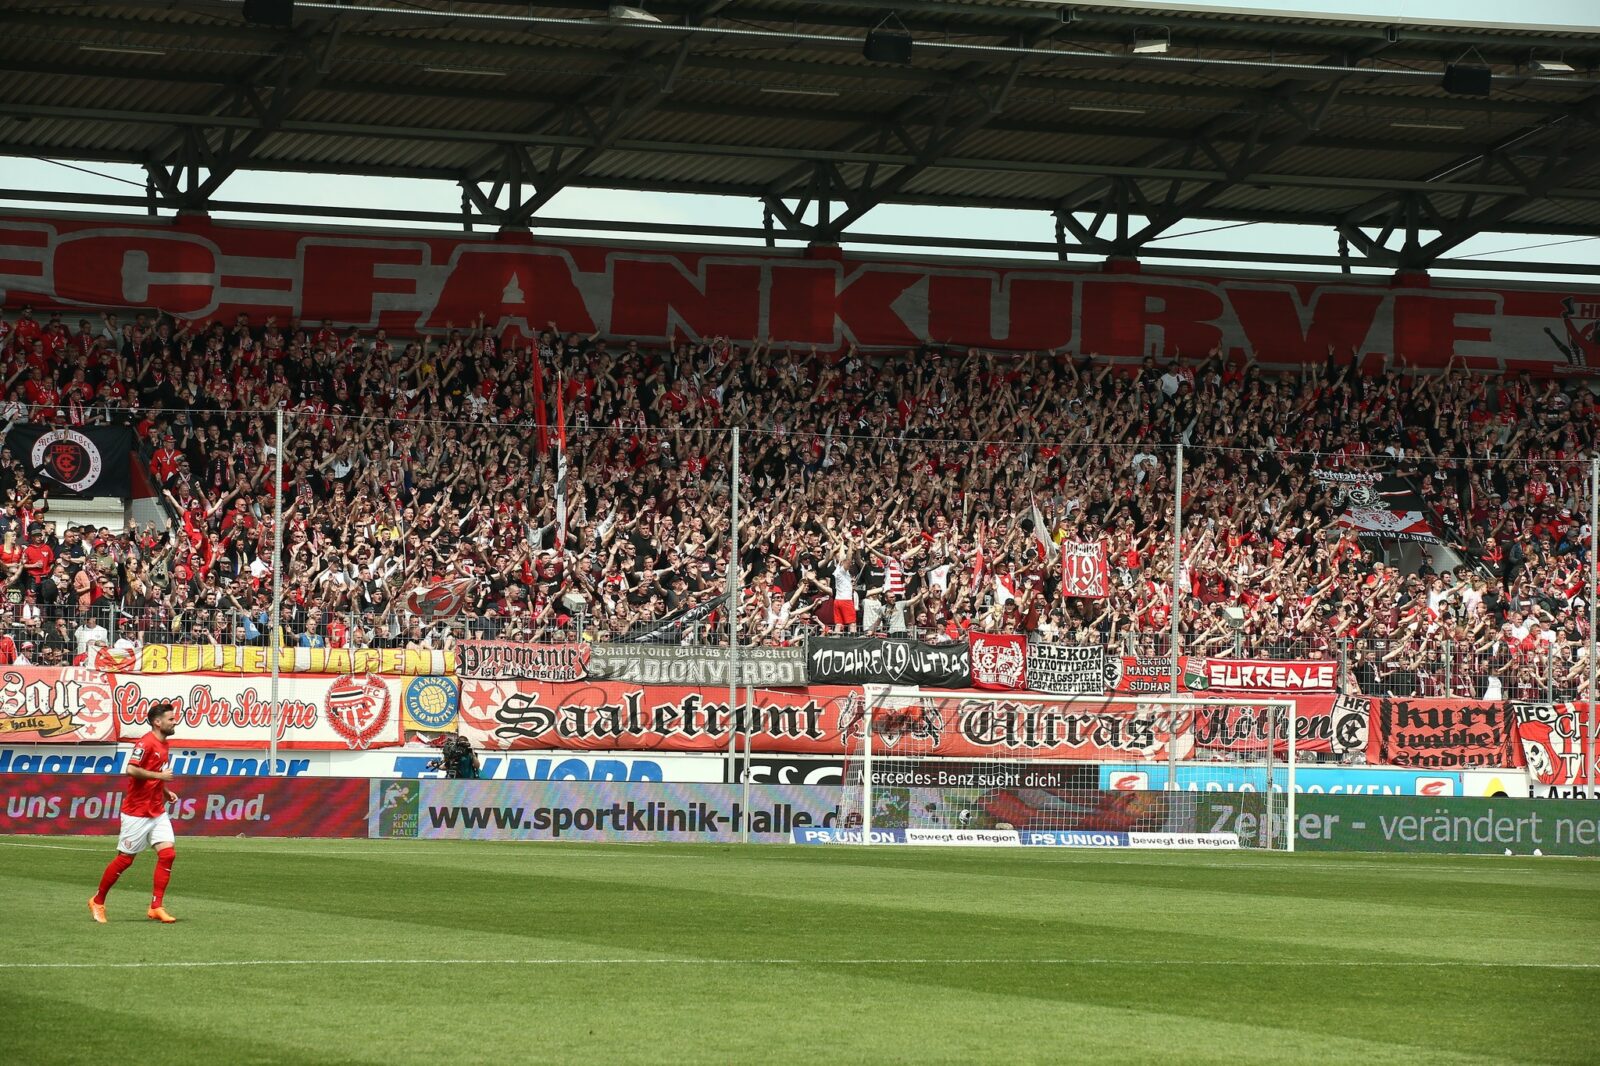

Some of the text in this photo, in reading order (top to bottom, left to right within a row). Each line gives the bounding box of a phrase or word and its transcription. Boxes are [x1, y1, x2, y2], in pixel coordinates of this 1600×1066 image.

[1072, 555, 1095, 586] 19
[142, 644, 295, 673] BULLEN
[310, 648, 431, 675] JAGEN
[457, 644, 577, 675] Pyromanie
[481, 665, 576, 679] ist Leidenschaft
[589, 658, 806, 684] STADIONVERBOT
[885, 643, 906, 674] 19
[910, 650, 970, 677] ULTRAS
[1137, 658, 1172, 666] SEKTION
[413, 677, 455, 697] FANSZENE
[1130, 679, 1171, 691] SÜDHAR
[1210, 664, 1334, 688] SURREALE
[187, 684, 231, 728] Per
[234, 687, 317, 740] Sempre
[410, 696, 455, 723] LOKOMOTIVE
[495, 689, 825, 740] Saalefront
[959, 699, 1160, 750] Ultras
[1196, 697, 1333, 746] Köthen
[1392, 701, 1503, 729] kurt
[169, 751, 310, 777] übner
[858, 770, 1061, 787] Mercedes-Benz sucht dich!
[7, 792, 271, 821] uns roll as Rad.
[393, 813, 418, 821] SPORT
[429, 801, 864, 837] www.sportklinik-halle.de
[393, 821, 418, 829] KLINIK
[393, 828, 418, 836] HALLE
[805, 831, 896, 843] PS UNION
[910, 833, 1016, 843] bewegt die Region
[1211, 804, 1340, 847] Zepter
[1380, 808, 1543, 844] verändert
[1031, 833, 1119, 846] PS UNION
[1132, 836, 1237, 847] bewegt die Region
